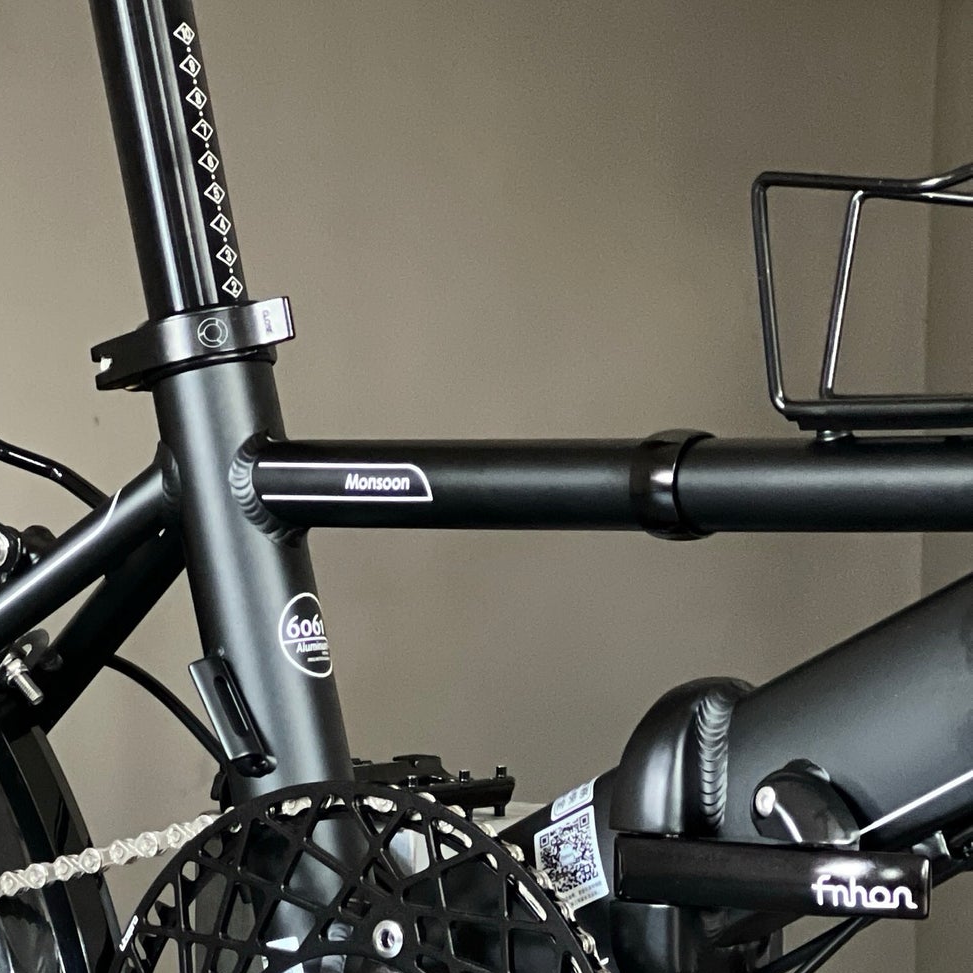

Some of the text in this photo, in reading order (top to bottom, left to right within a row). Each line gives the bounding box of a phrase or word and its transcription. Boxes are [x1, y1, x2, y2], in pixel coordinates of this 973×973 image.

[345, 473, 411, 490] Monsoon
[286, 613, 325, 639] 6061
[811, 874, 919, 910] fnhon
